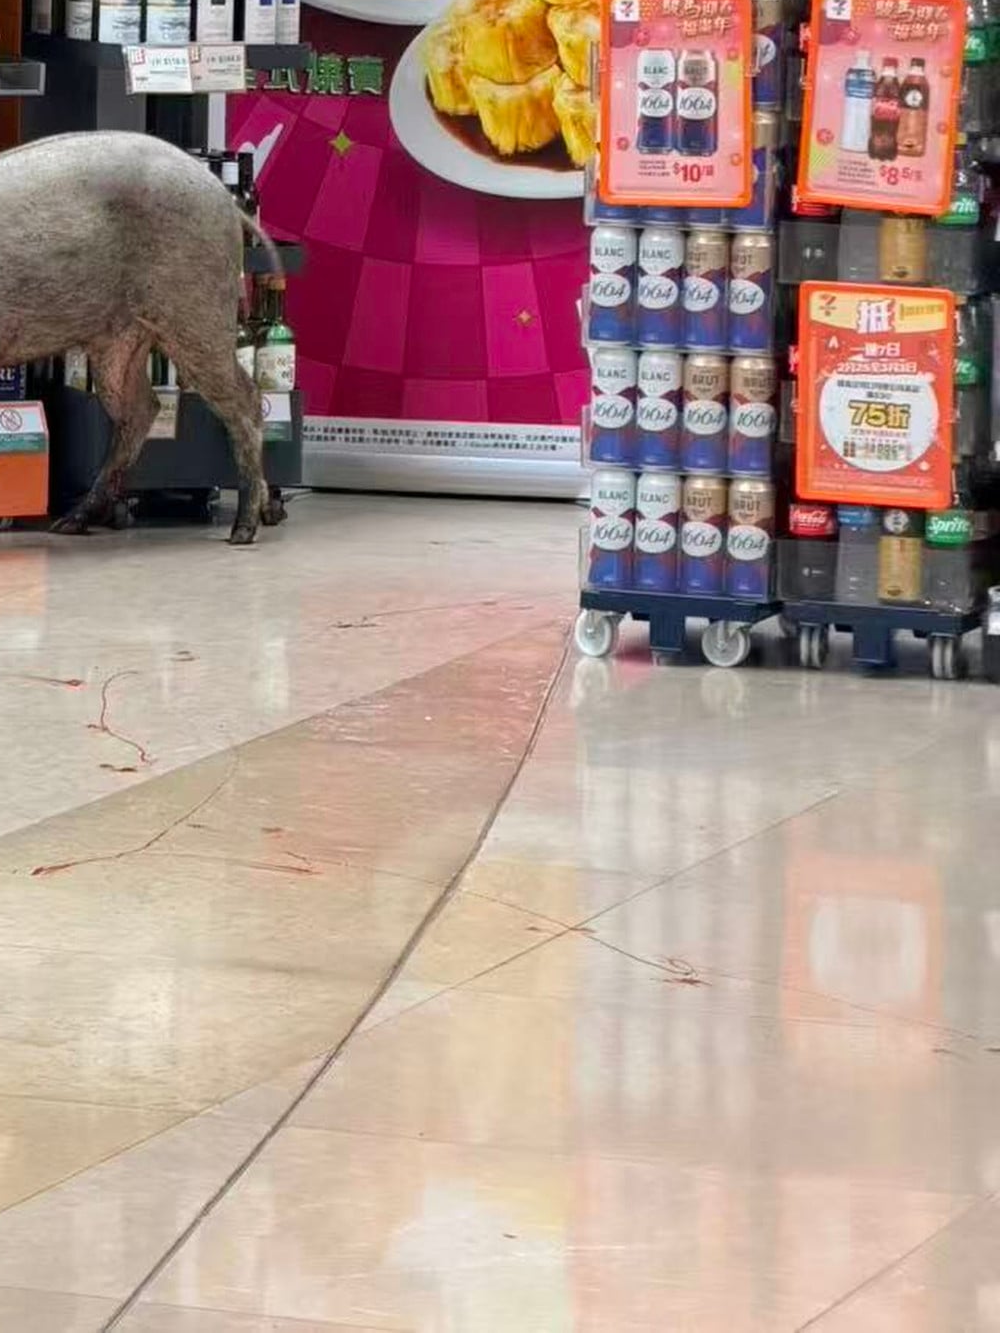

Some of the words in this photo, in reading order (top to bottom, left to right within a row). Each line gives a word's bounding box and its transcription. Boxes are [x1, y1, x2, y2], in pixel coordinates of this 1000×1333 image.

[598, 368, 628, 379] BLANC
[692, 374, 720, 386] BRUT
[687, 407, 724, 425] 1664
[849, 400, 911, 429] 75折
[599, 489, 630, 502] BLANC
[640, 492, 671, 504] BLANC
[734, 500, 762, 513] BRUT
[928, 515, 972, 534] Sprite
[593, 524, 631, 542] 1664
[729, 532, 766, 550] 1664
